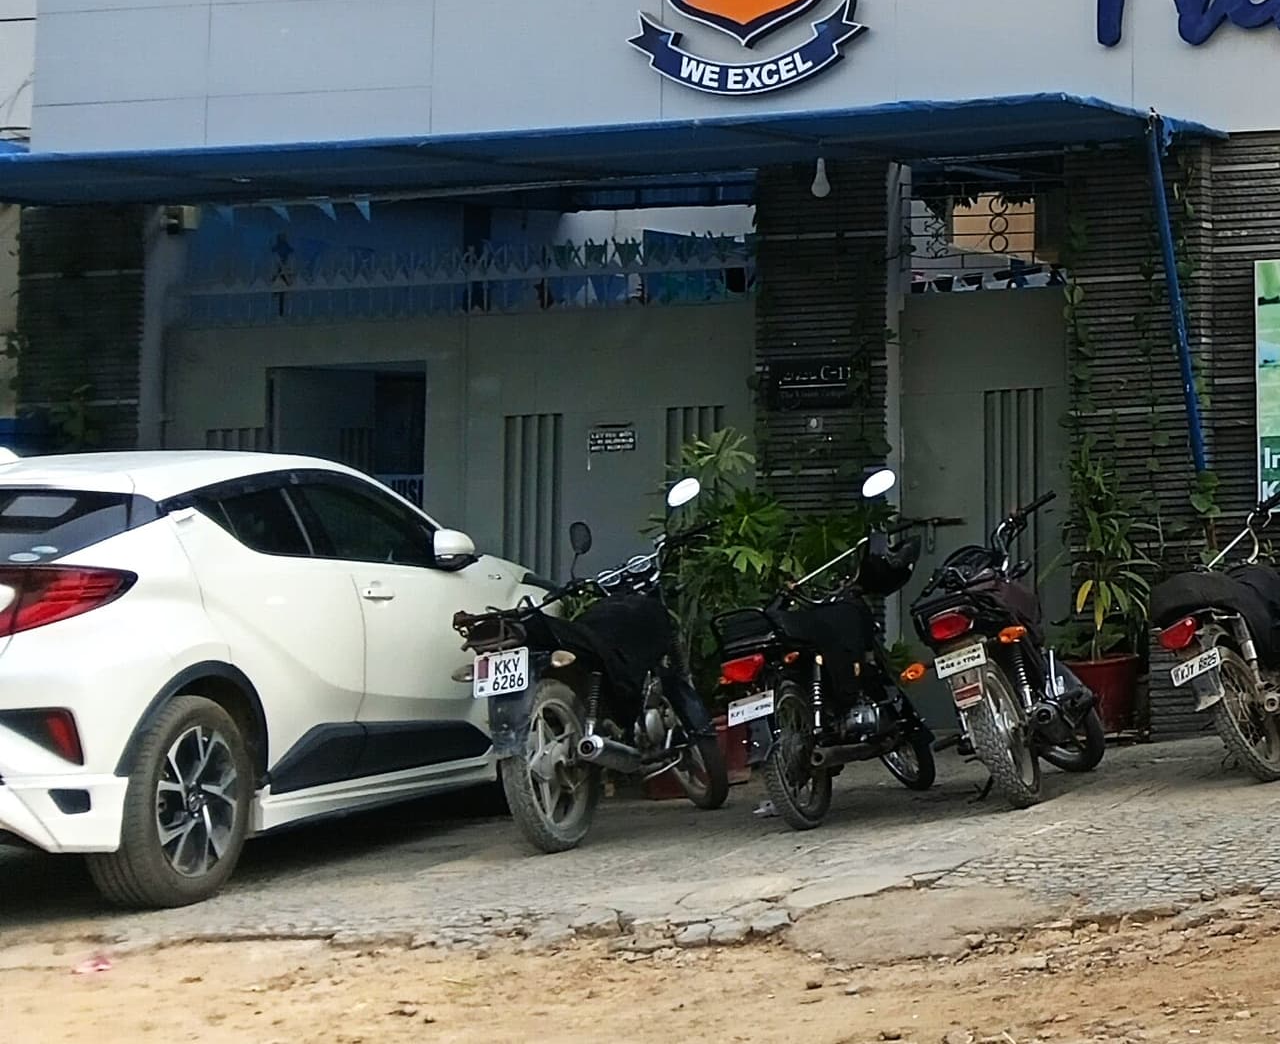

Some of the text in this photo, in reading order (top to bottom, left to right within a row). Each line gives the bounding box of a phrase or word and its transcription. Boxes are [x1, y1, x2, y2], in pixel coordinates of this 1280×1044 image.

[680, 52, 813, 90] WE EXCEL
[494, 657, 521, 676] KKY
[492, 672, 524, 691] 6286
